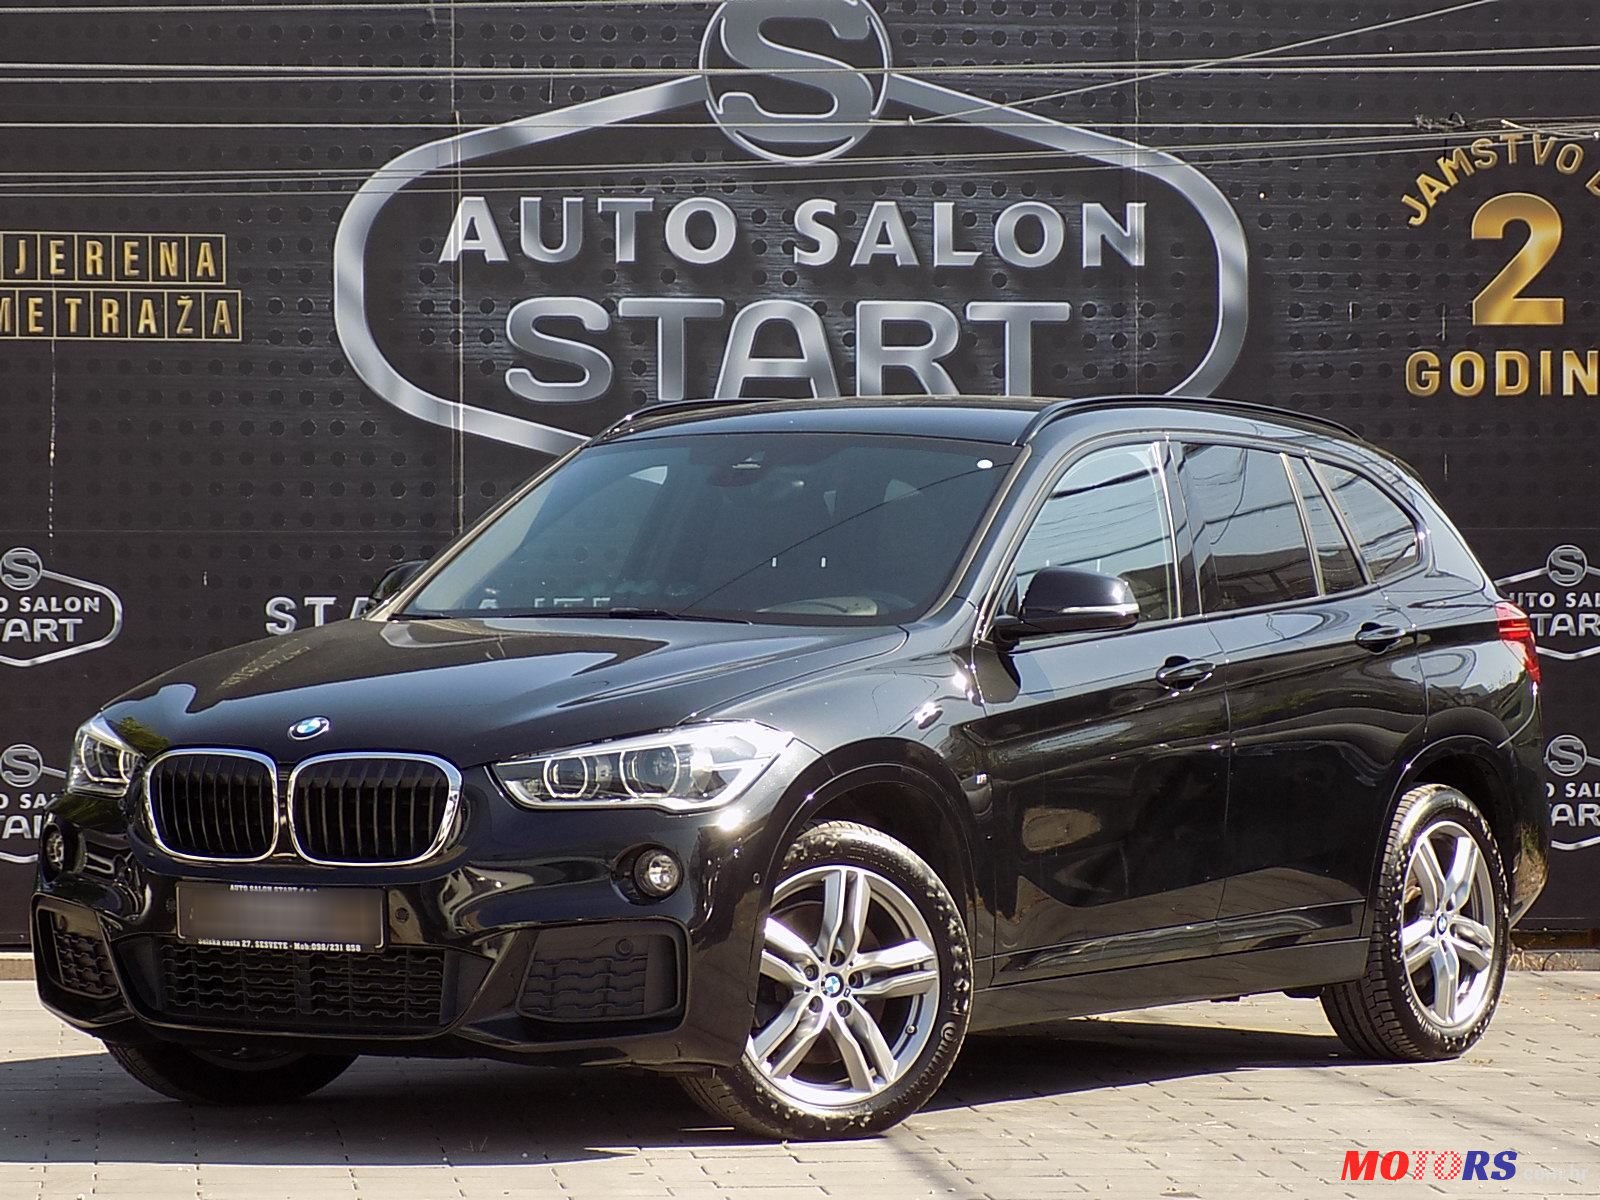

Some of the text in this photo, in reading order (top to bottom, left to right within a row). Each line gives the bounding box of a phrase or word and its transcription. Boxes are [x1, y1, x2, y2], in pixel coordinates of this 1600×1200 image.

[714, 0, 876, 145] S
[1401, 132, 1584, 226] JAMSTVO
[15, 239, 216, 277] JERENA
[438, 196, 1147, 268] AUTO SALON
[1471, 191, 1563, 326] 2
[503, 296, 1073, 402] START
[1405, 350, 1599, 397] GODIN
[0, 618, 83, 643] ART
[19, 596, 100, 613] SALON
[229, 884, 248, 892] AUTO
